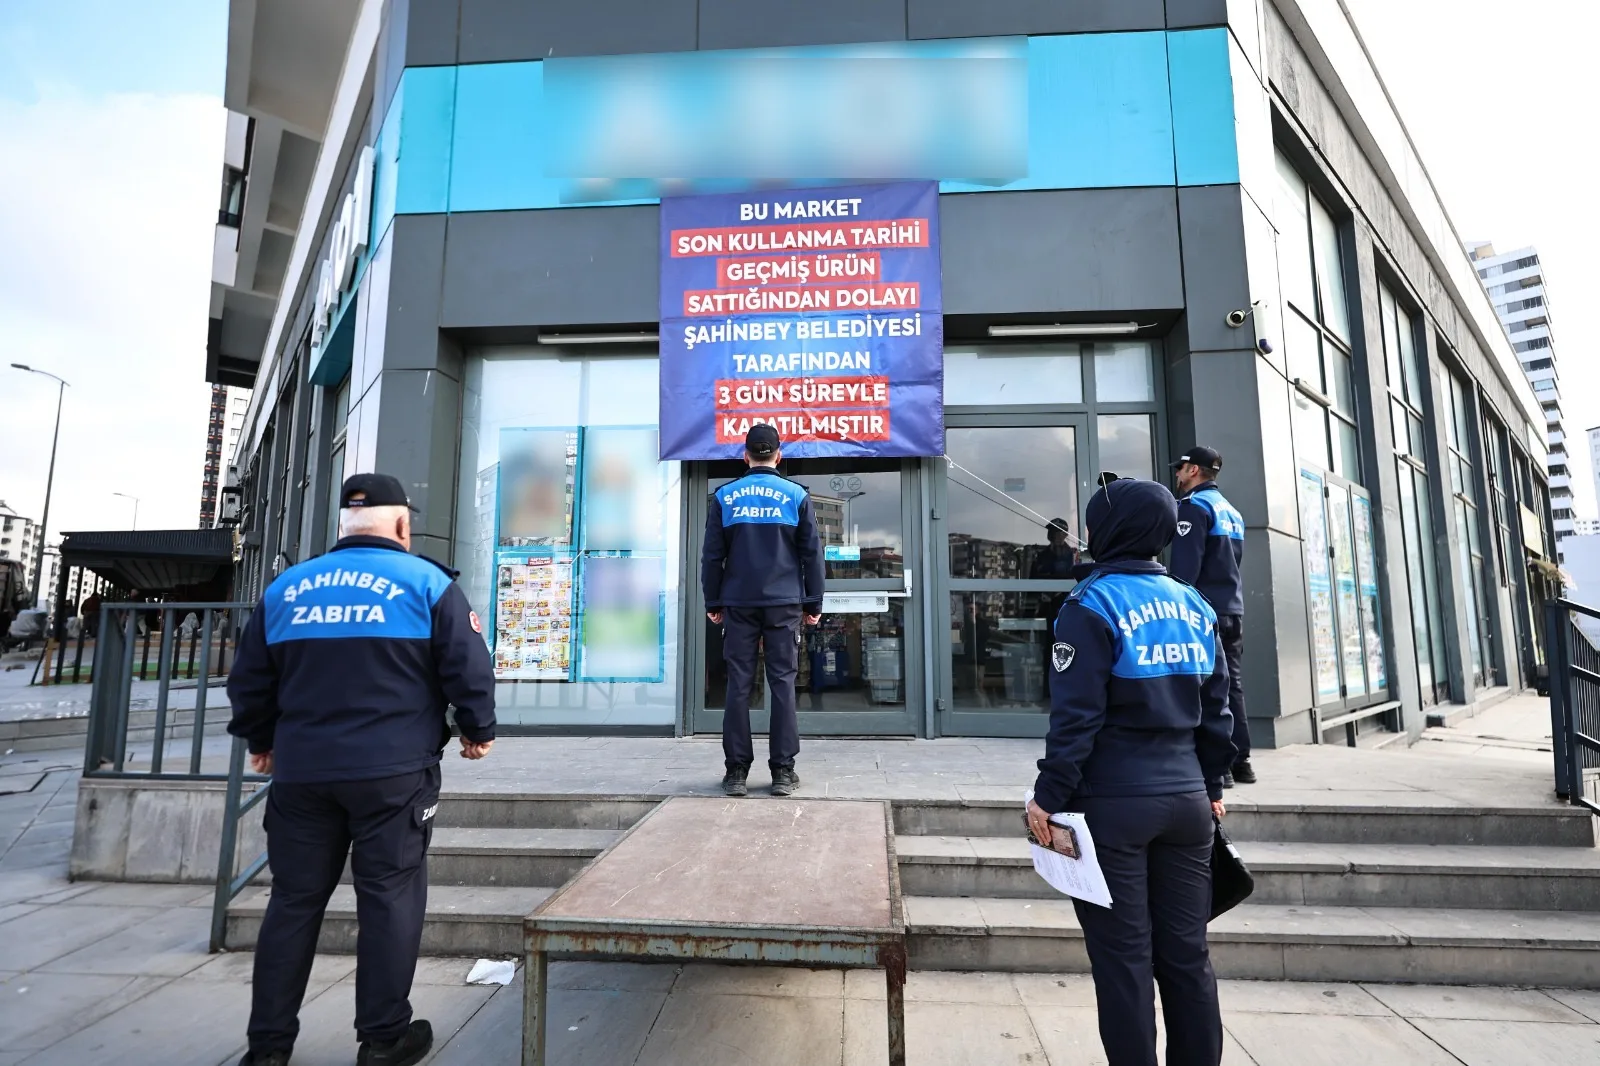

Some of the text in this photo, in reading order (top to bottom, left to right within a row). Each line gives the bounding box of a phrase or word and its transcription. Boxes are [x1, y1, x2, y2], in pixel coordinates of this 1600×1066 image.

[740, 199, 862, 221] BU MARKET
[678, 221, 920, 254] SON KULLANMA TARİHİ
[727, 254, 875, 285] GEÇMİŞ ÜRÜN
[688, 288, 916, 313] SATTIĞINDAN DOLAYI
[684, 313, 921, 350] ŞAHİNBEY BELEDİYESİ
[733, 352, 870, 373] TARAFINDAN
[719, 379, 886, 405] 3 GÜN SÜREYLE
[732, 506, 782, 518] ZABITA
[284, 568, 405, 603] ŞAHİNBEY
[291, 605, 386, 625] ZABITA
[1135, 643, 1208, 666] ZABITA
